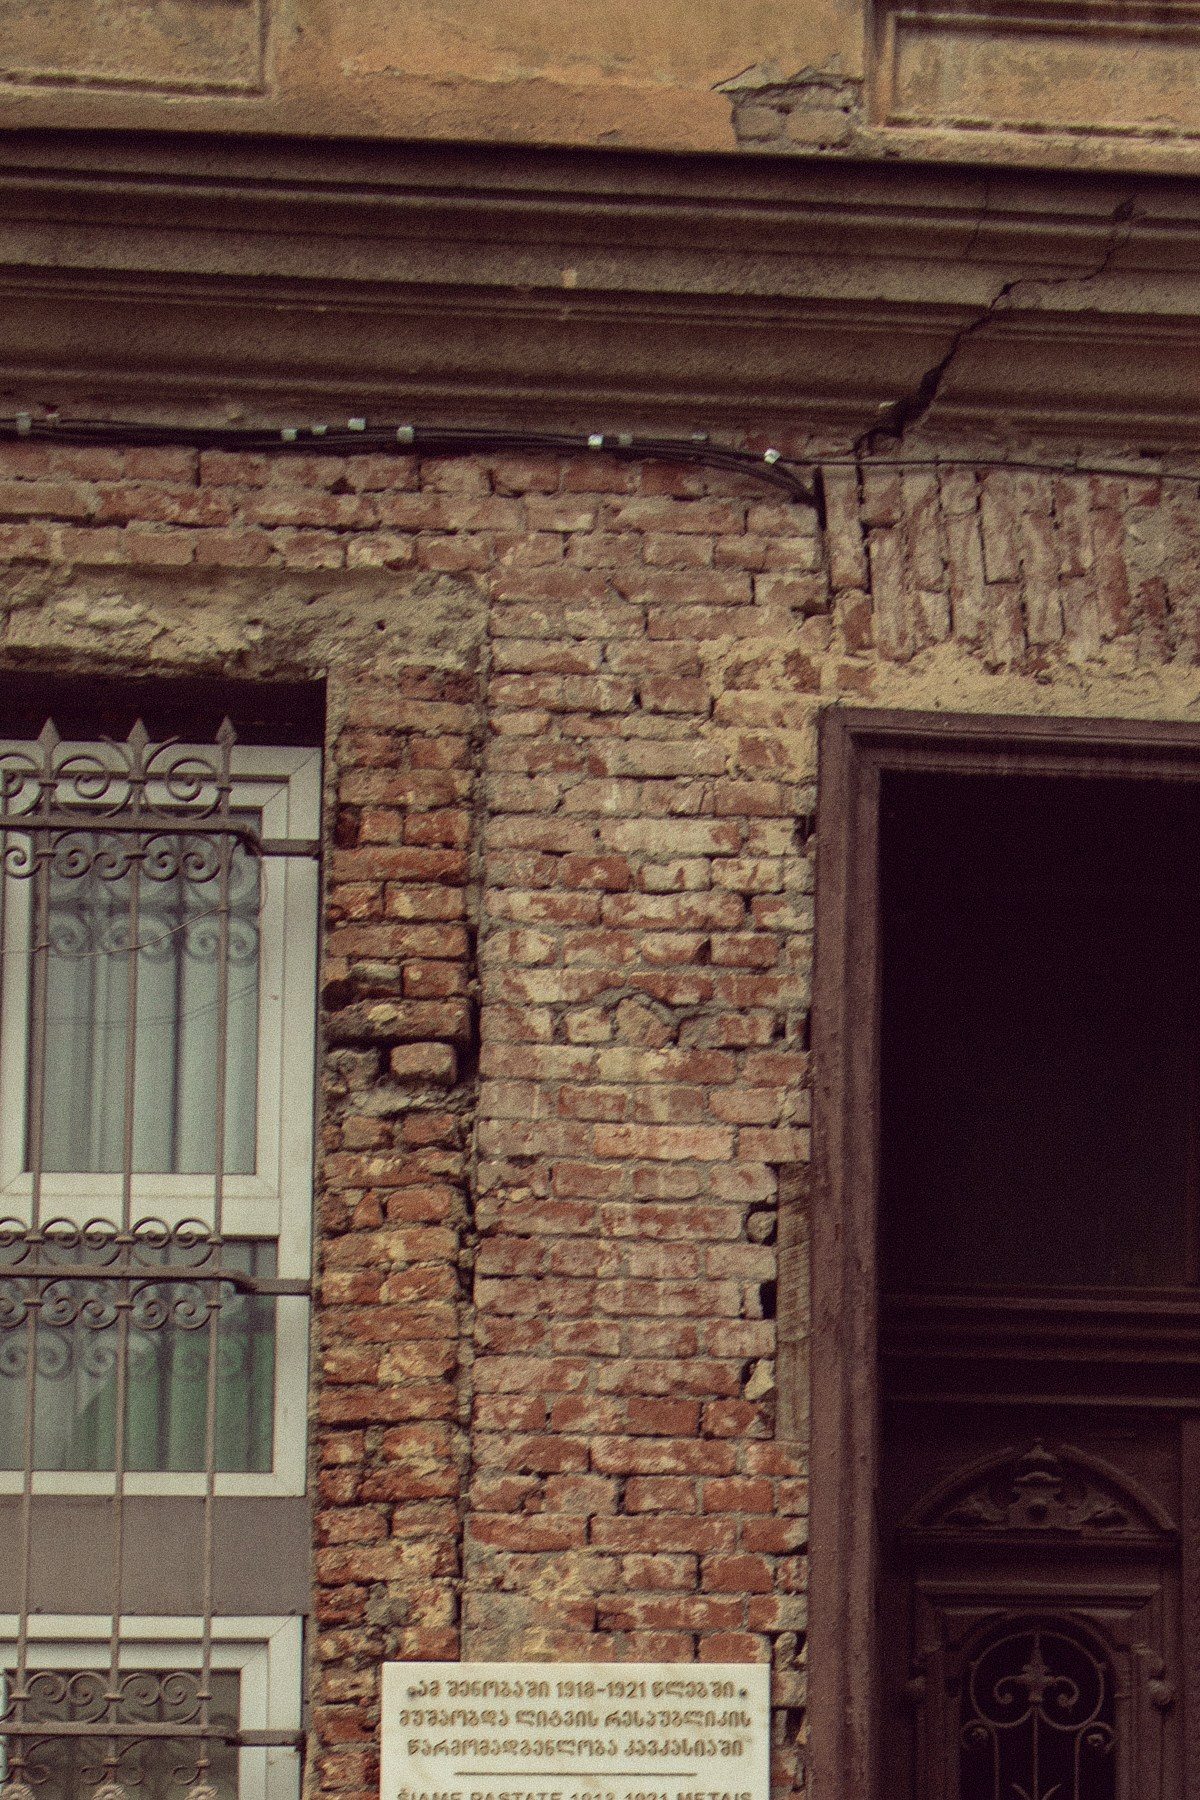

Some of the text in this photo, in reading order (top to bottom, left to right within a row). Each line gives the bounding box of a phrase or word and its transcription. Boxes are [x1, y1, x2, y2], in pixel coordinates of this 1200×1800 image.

[416, 1679, 736, 1699] ამ შენობაში 1918-1921 წლებში
[399, 1709, 752, 1728] მუშაობდა ლიტვის რესპუბლიკის
[623, 1738, 744, 1757] კავკასიაში
